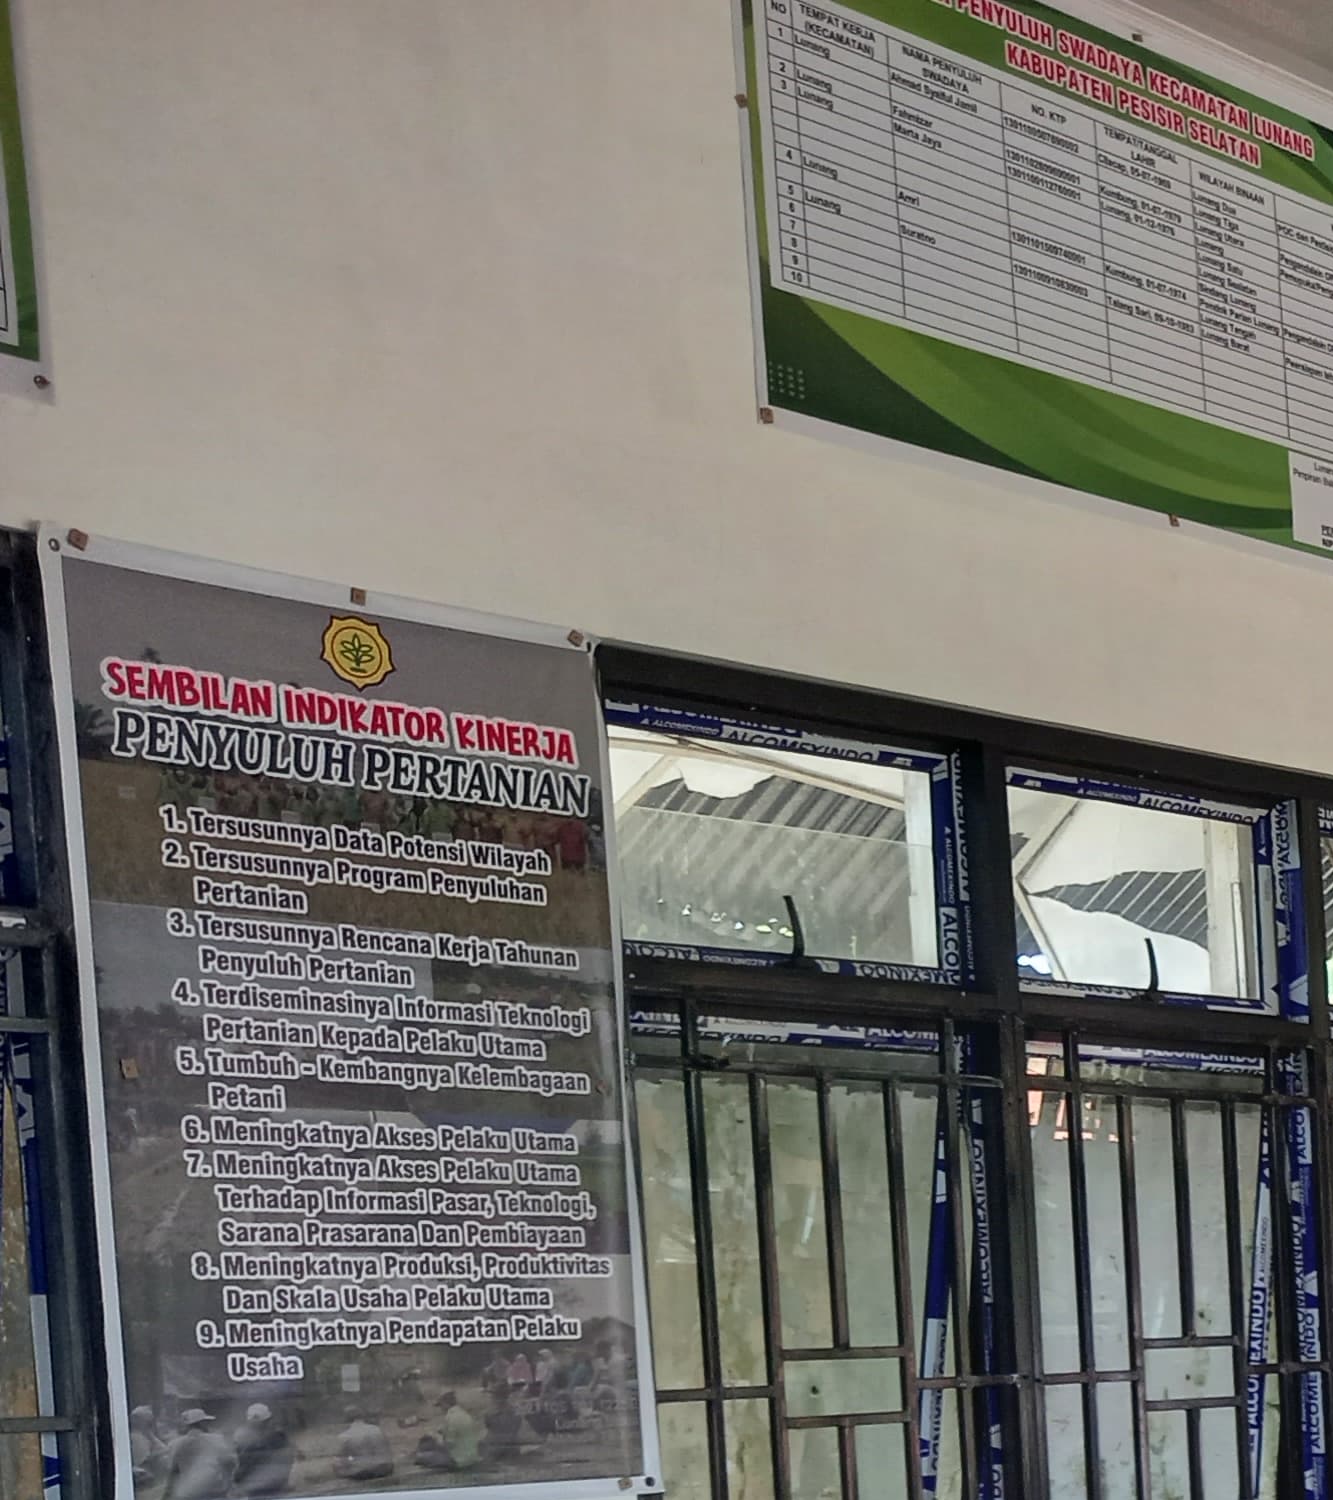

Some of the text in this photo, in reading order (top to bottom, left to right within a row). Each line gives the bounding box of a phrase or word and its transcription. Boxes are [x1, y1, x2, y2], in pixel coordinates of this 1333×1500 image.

[770, 0, 787, 15] NO
[800, 3, 876, 43] TEMPAT KERJA
[804, 22, 875, 59] (KECAMATAN)
[902, 46, 983, 86] NAMA PENYULUH
[956, 0, 1314, 160] PENYULUH SWADAYA KECAMATAN LUNANG
[1004, 43, 1113, 107] KABUPATEN
[1118, 92, 1185, 136] PESISIR
[1187, 119, 1261, 167] SELATAN
[1049, 110, 1067, 125] KTP
[105, 660, 576, 765] SEMBILAN INDIKATOR KINERJA
[113, 711, 591, 817] PENYULUH PERTANIAN
[163, 808, 550, 876] 1. Tersusunnya Data Potensi Wilayah
[164, 842, 546, 906] 2. Tersusunnya Program Penyuluhan
[195, 880, 306, 912] Pertanian
[168, 912, 578, 969] 3. Tersusunnya Rencana Kerja Tahunan
[200, 949, 414, 987] Penyuluh Pertanian
[172, 982, 591, 1035] 4. Terdiseminasinya Informasi Teknologi
[205, 1016, 546, 1060] Pertanian Kepada Pelaku Utama
[178, 1050, 590, 1096] 5. Tumbuh - Kembangnya Kelembagaan
[208, 1084, 287, 1112] Petani
[181, 1117, 578, 1155] 6. Meningkatnya Akses Pelaku Utama
[186, 1152, 580, 1185] 7. Meningkatnya Akses Pelaku Utama
[217, 1187, 596, 1220] Terhadap Informasi Pasar, Teknologi,
[219, 1221, 586, 1252] Sarana Prasarana Dan Pembiayaan
[192, 1255, 611, 1284] 8. Meningkatnya Produksi, Produktivitas
[225, 1286, 552, 1313] Dan Skala Usaha Pelaku Utama
[196, 1316, 581, 1348] 9. Meningkatnya Pendapatan Pelaku
[228, 1354, 303, 1381] Usaha
